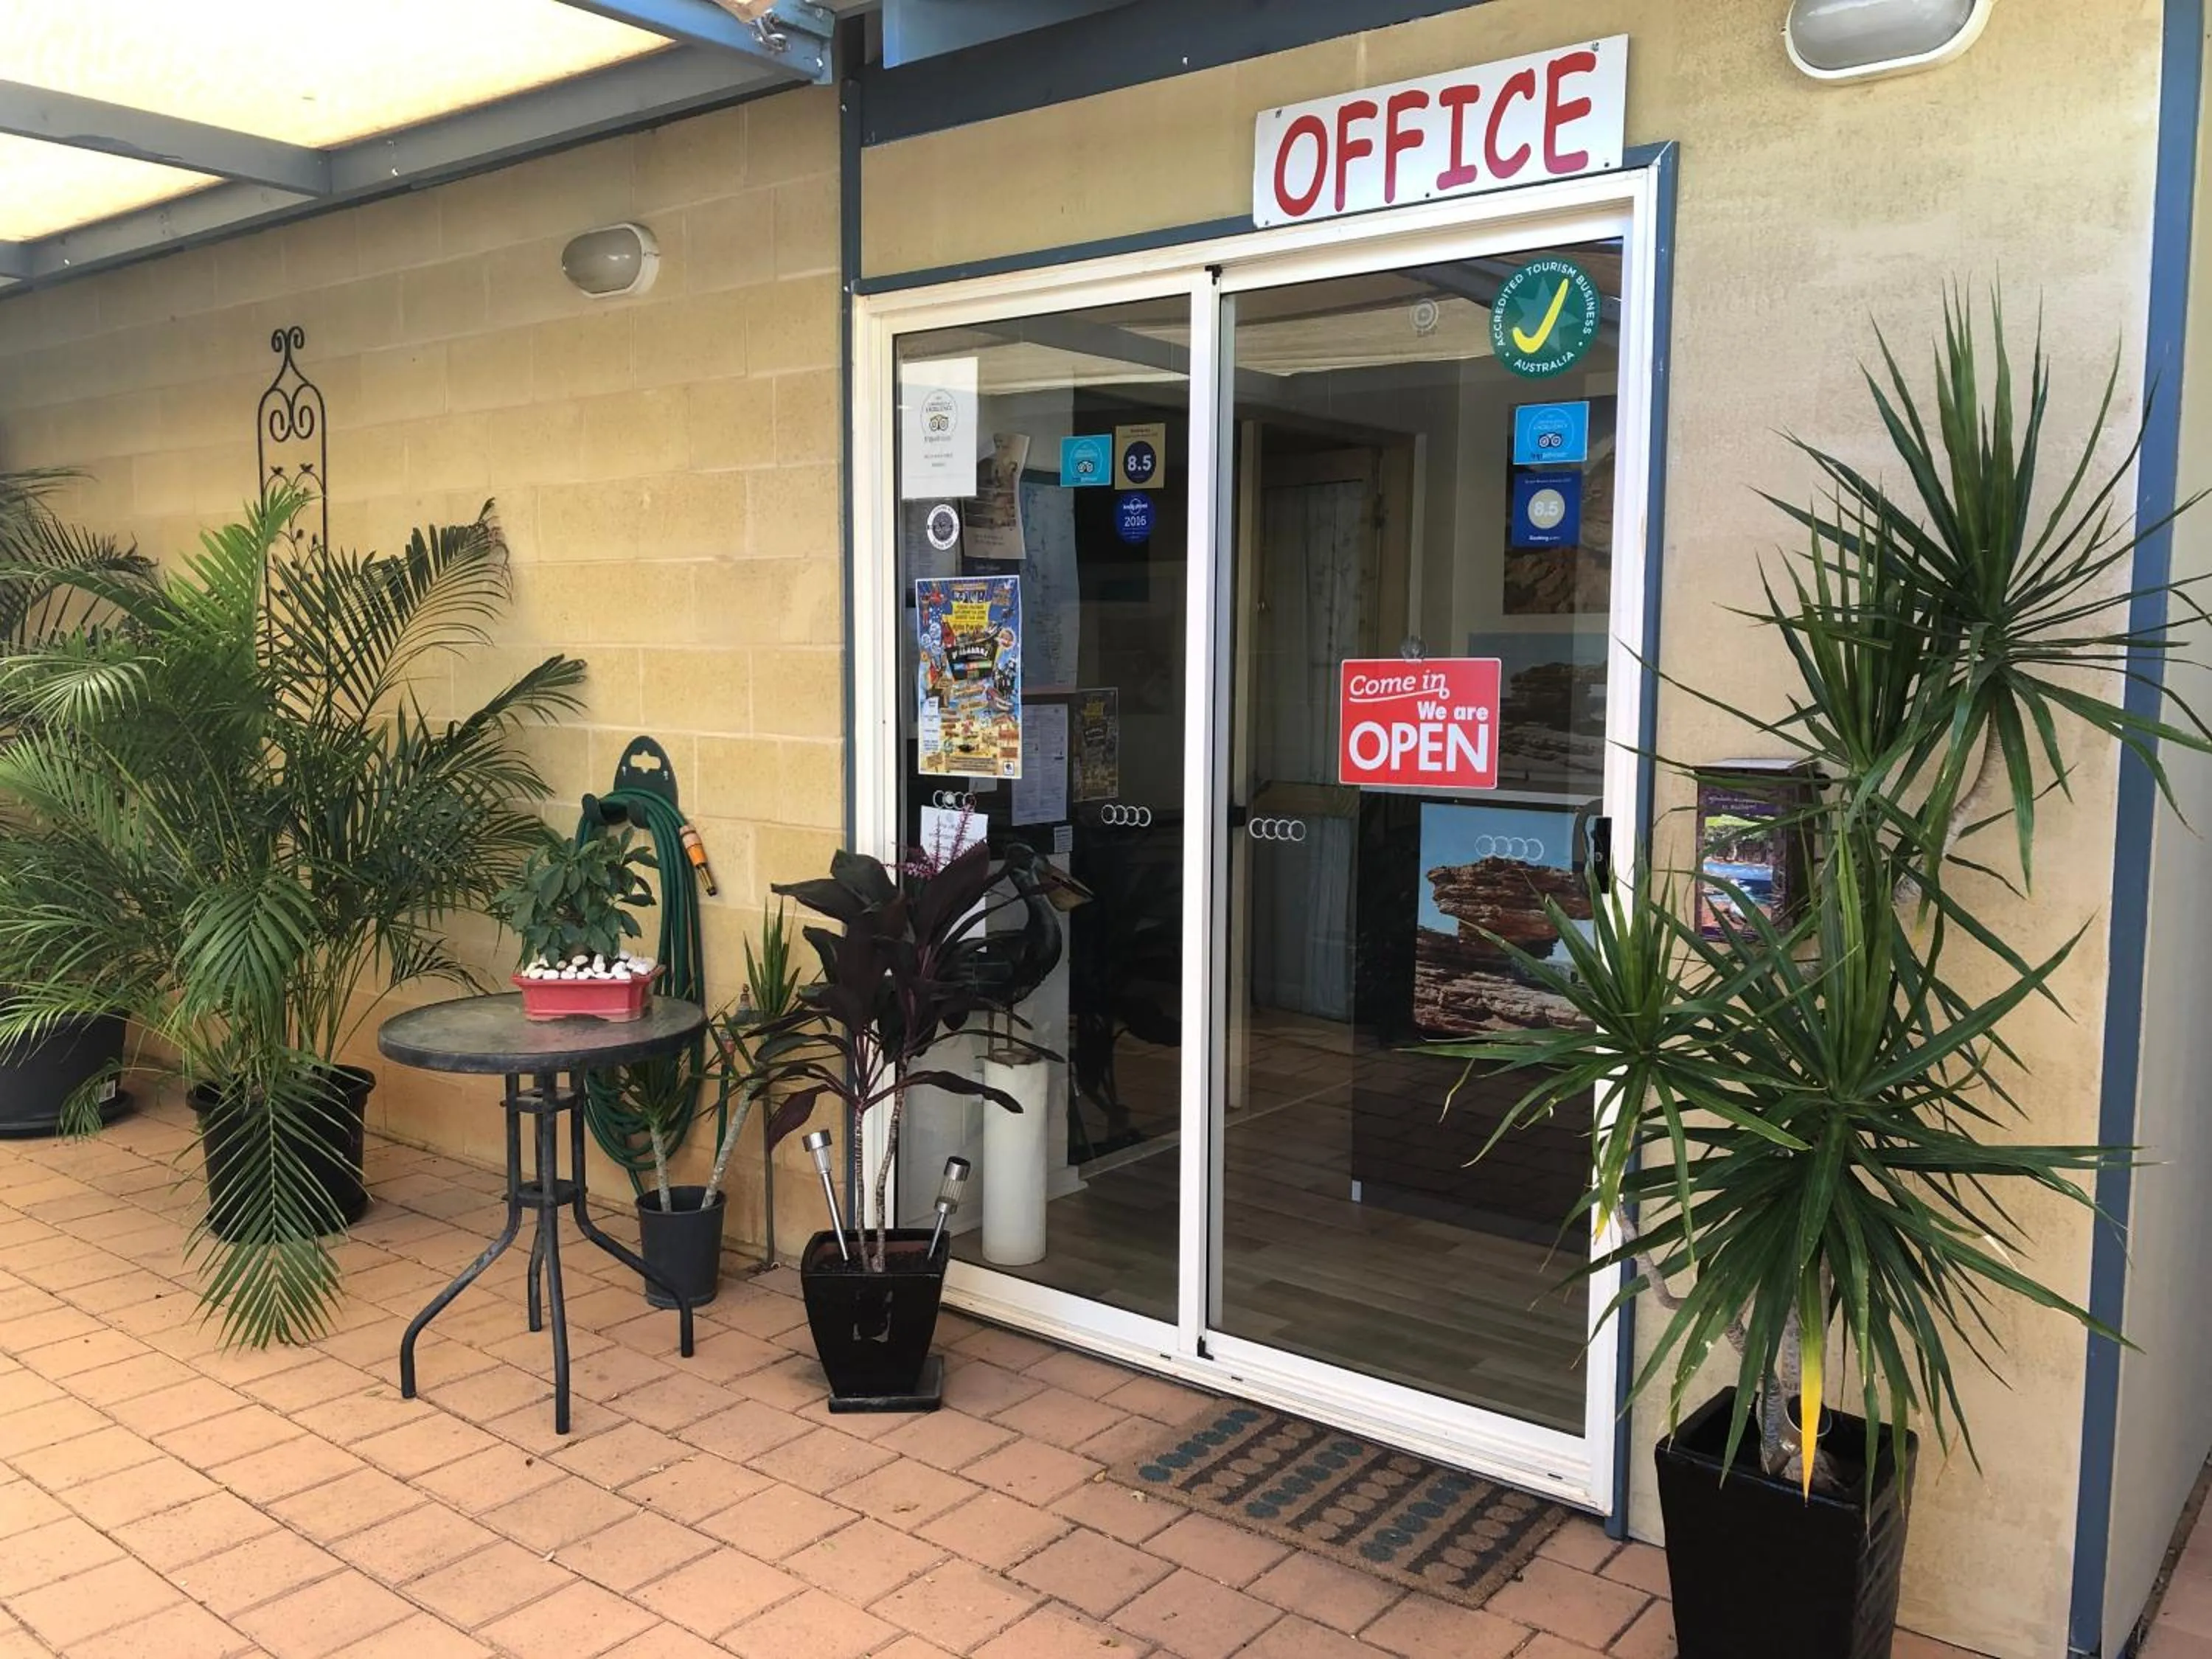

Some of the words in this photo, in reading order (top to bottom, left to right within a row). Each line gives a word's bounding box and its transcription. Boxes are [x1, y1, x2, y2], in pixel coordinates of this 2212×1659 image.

[1274, 52, 1596, 217] OFFICE
[1493, 274, 1524, 346] ACCREDITED
[1526, 262, 1577, 278] TOURISM
[1576, 275, 1595, 335] BUSINESS
[1514, 351, 1575, 372] AUSTRALIA
[1127, 454, 1152, 471] 8.5
[1124, 515, 1147, 527] 2016
[1349, 674, 1416, 696] Come
[1422, 669, 1448, 695] in
[1417, 701, 1447, 720] We
[1453, 706, 1489, 720] are
[1349, 720, 1489, 773] OPEN
